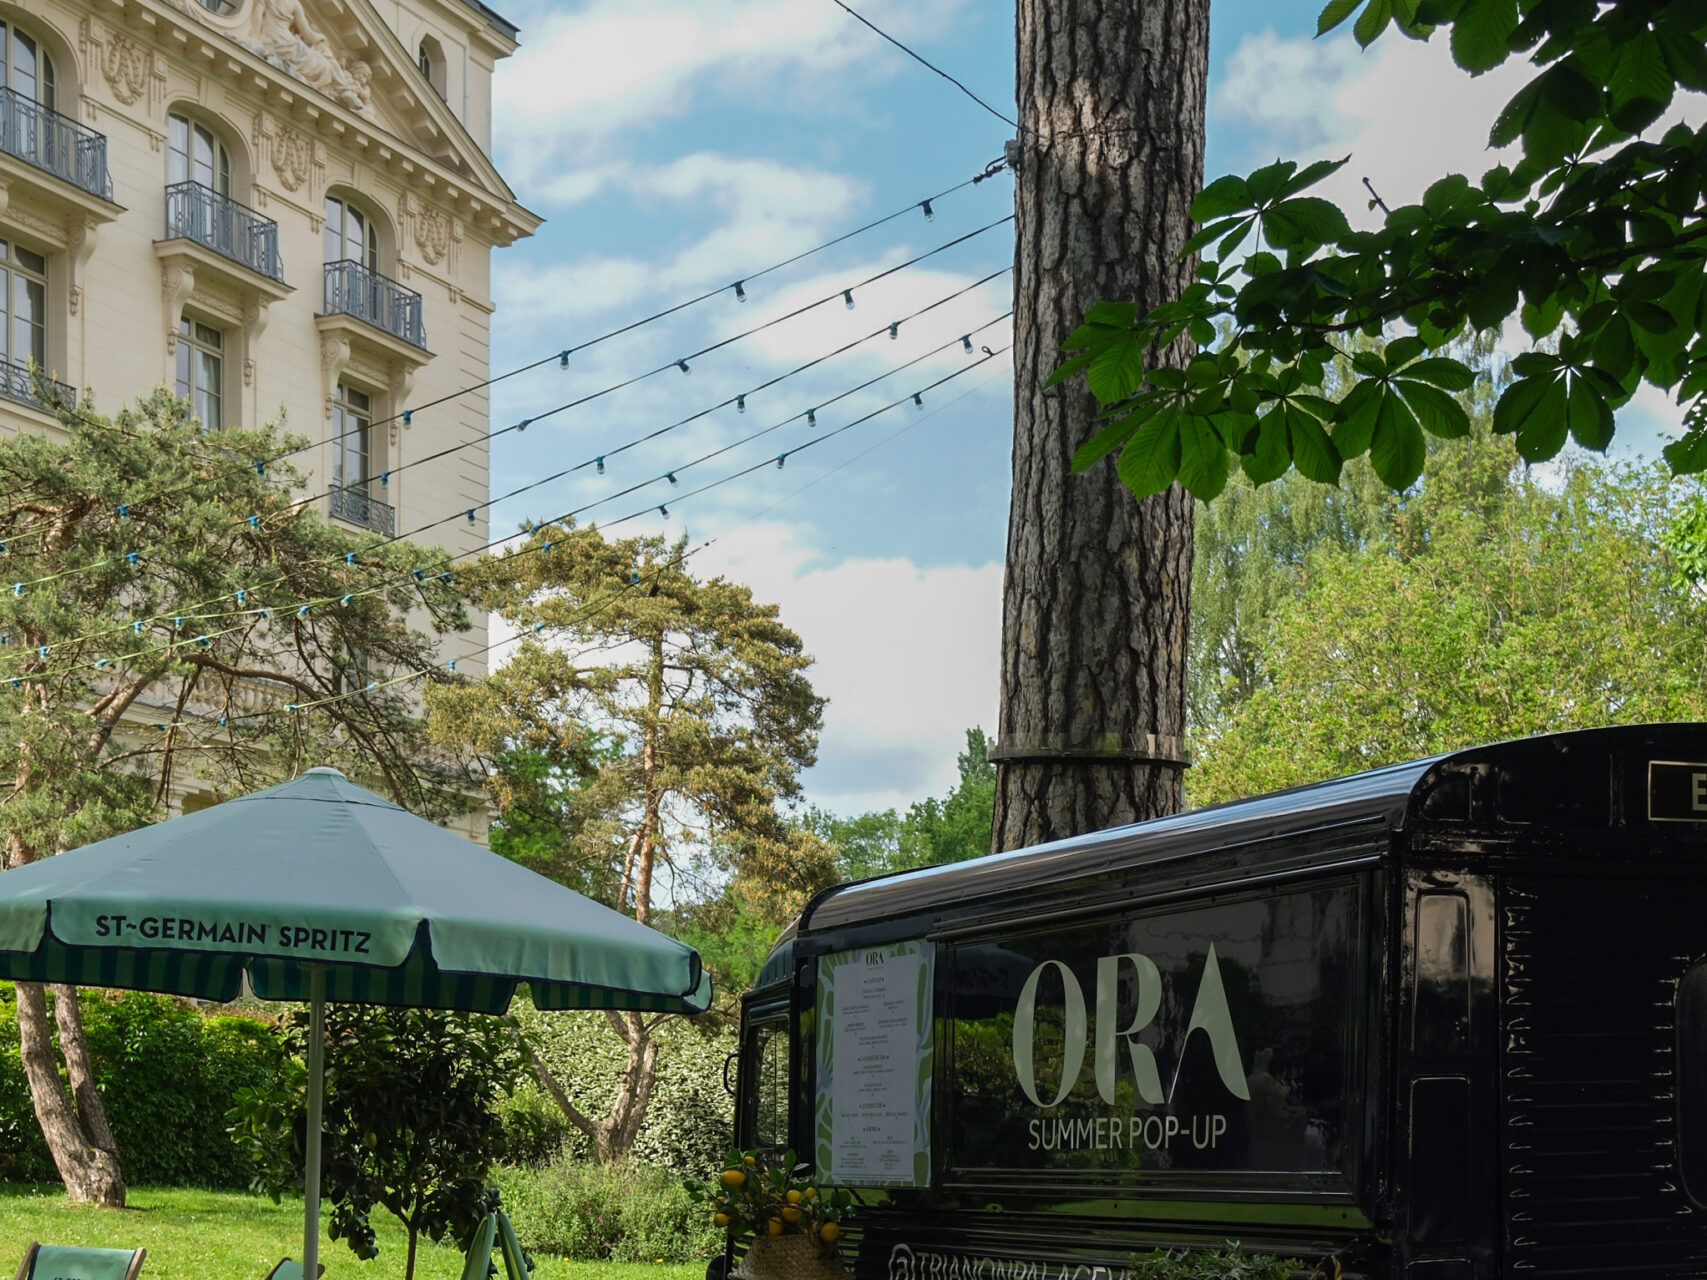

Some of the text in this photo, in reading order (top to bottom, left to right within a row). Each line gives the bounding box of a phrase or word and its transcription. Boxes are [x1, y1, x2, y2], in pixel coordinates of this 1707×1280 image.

[278, 926, 372, 954] SPRITZ
[865, 950, 885, 967] ORA
[1012, 940, 1251, 1108] ORA
[1028, 1115, 1227, 1150] SUMMER POP-UP
